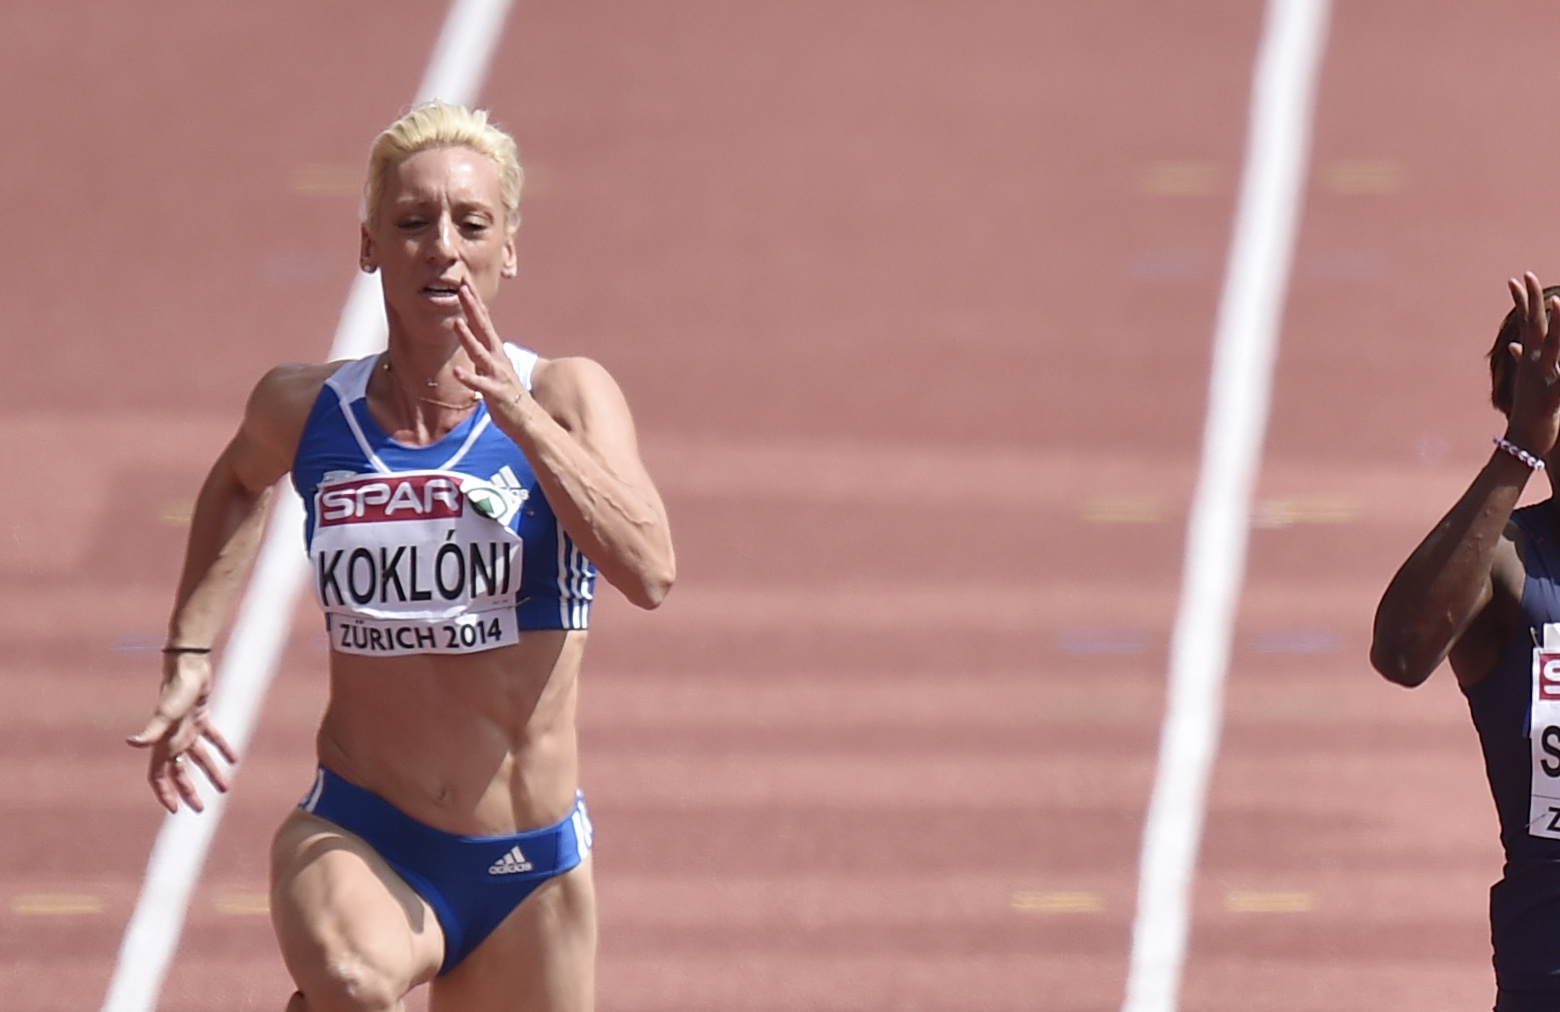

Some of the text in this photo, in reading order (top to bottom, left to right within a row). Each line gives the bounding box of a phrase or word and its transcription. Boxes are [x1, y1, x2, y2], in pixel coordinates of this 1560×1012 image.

[322, 479, 459, 520] SPAR
[318, 529, 511, 607] KOKLÓNI
[340, 618, 502, 650] ZÜRICH 2014
